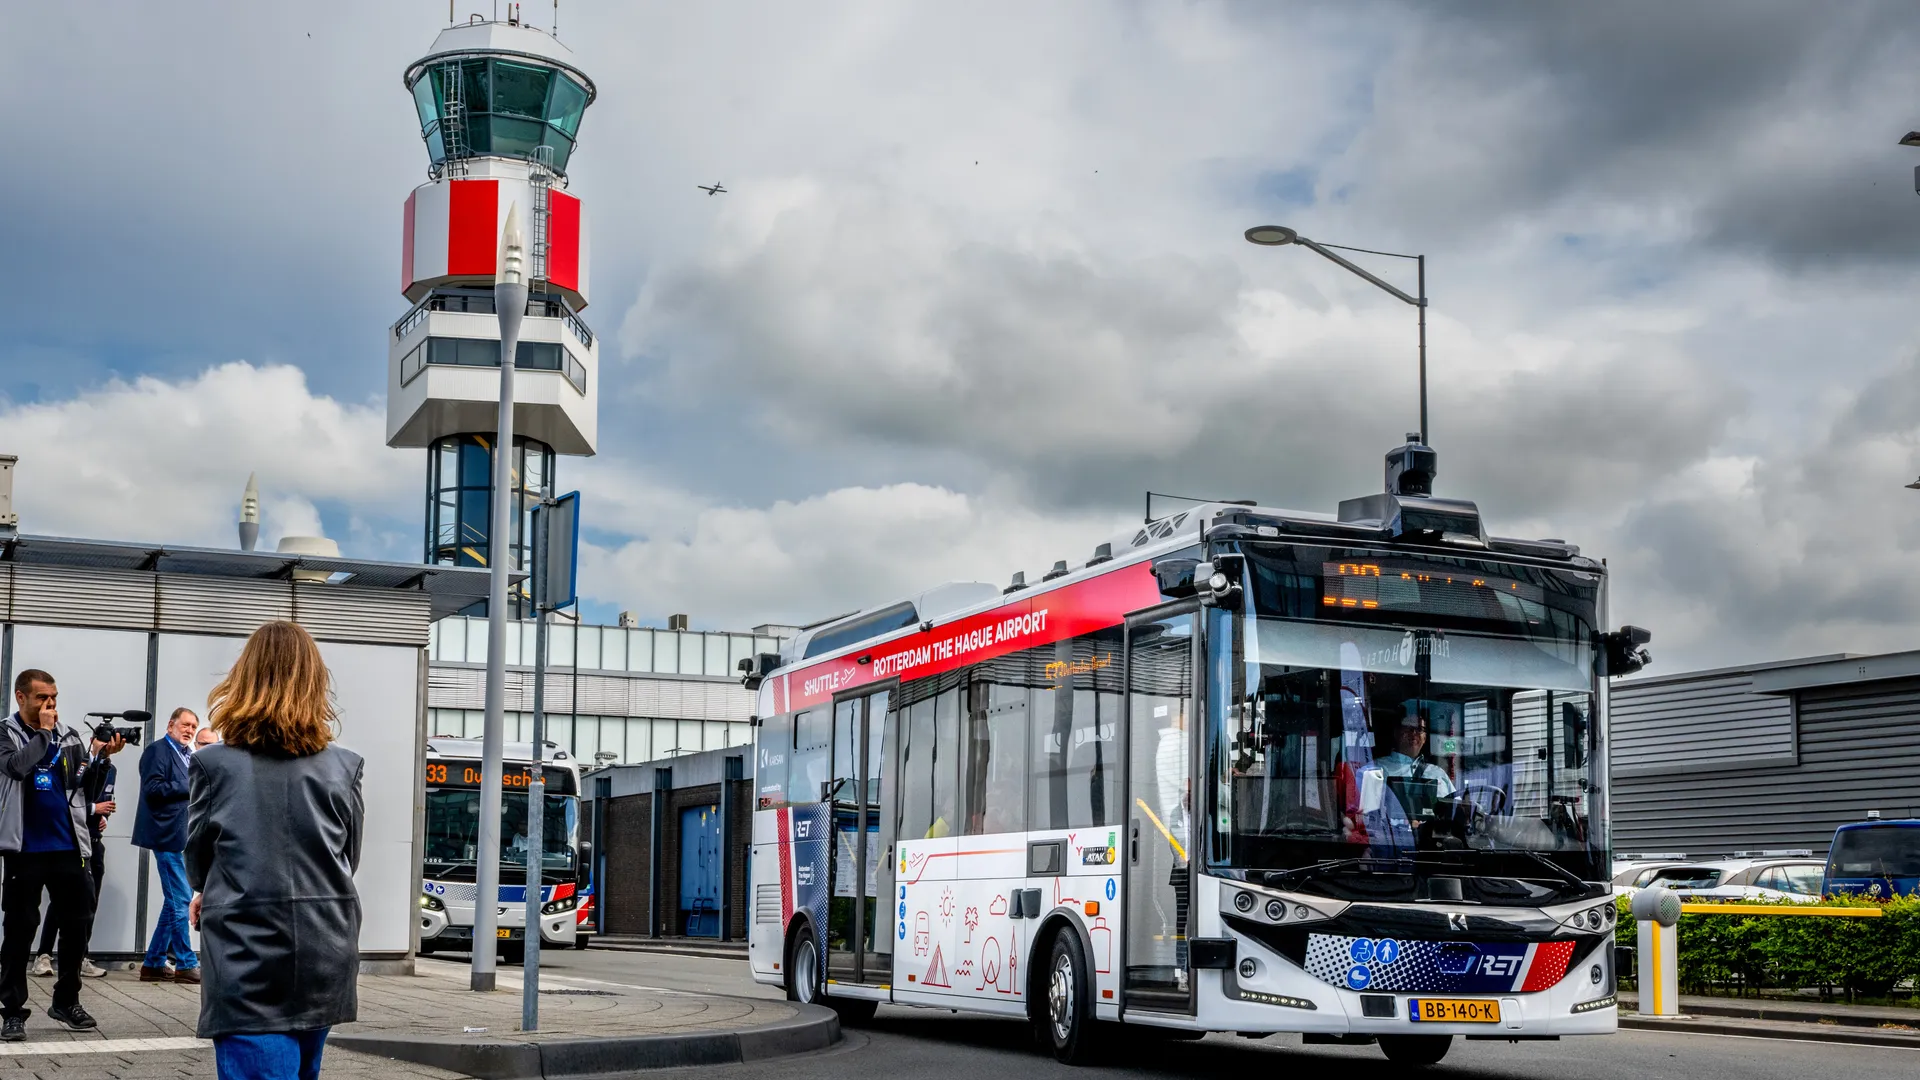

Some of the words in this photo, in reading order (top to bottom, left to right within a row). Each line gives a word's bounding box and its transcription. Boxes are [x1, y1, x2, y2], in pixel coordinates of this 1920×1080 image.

[804, 671, 839, 697] SHUTTLE
[873, 645, 931, 677] ROTTERDAM
[933, 638, 953, 661] THE
[955, 625, 993, 656] HAGUE
[995, 609, 1048, 643] AIRPORT
[426, 763, 447, 783] 33
[464, 768, 546, 787] Ovsch
[797, 820, 812, 838] RET
[1086, 853, 1105, 862] ATAK
[1482, 955, 1523, 976] RET
[1425, 1002, 1493, 1019] BB-140-K
